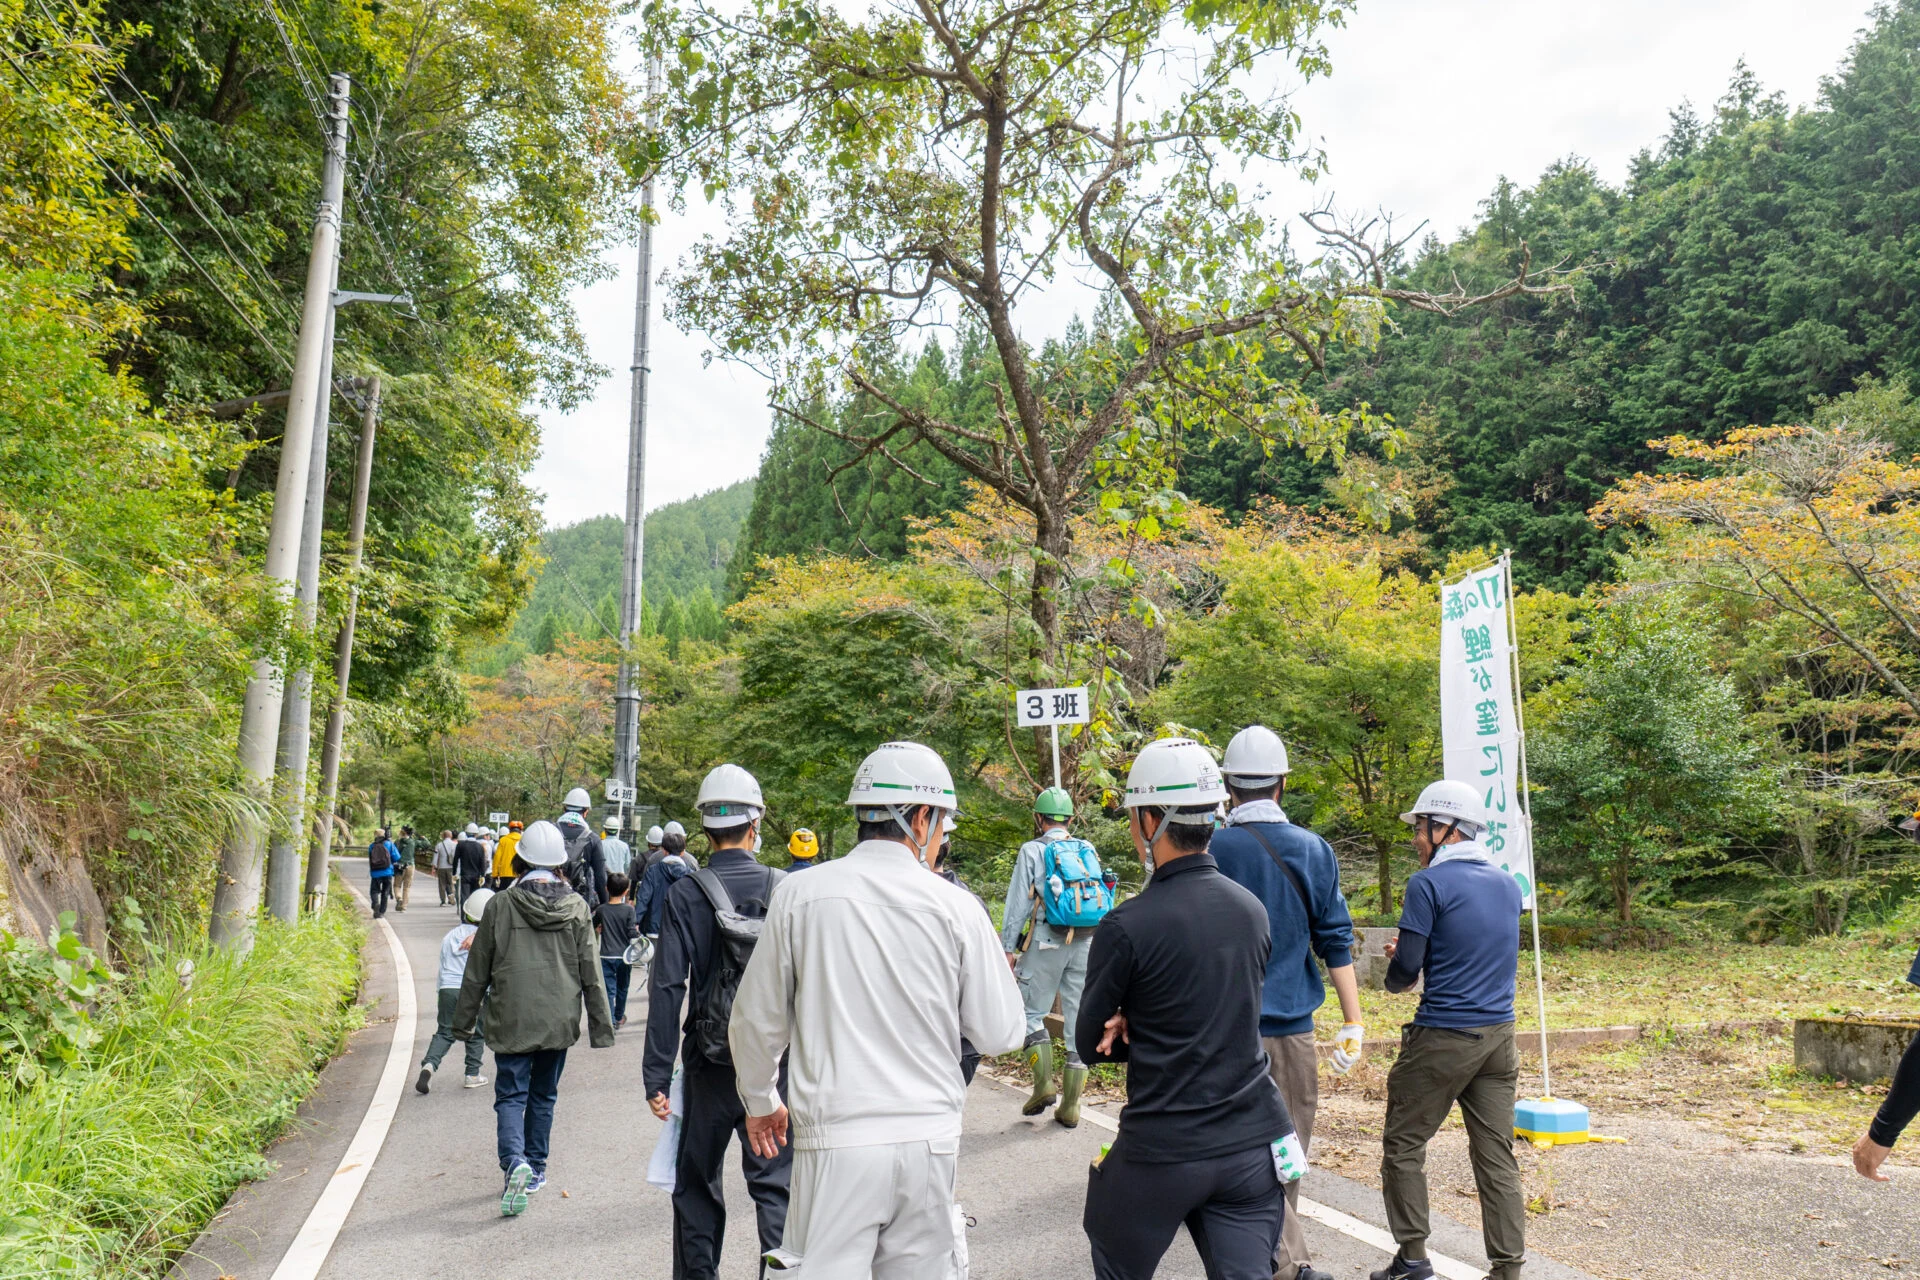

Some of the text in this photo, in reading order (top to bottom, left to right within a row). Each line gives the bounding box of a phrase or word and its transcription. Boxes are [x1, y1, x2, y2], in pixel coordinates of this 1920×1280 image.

[1026, 693, 1080, 719] 3班
[611, 788, 632, 800] 4班
[913, 784, 942, 794] ヤマゼン
